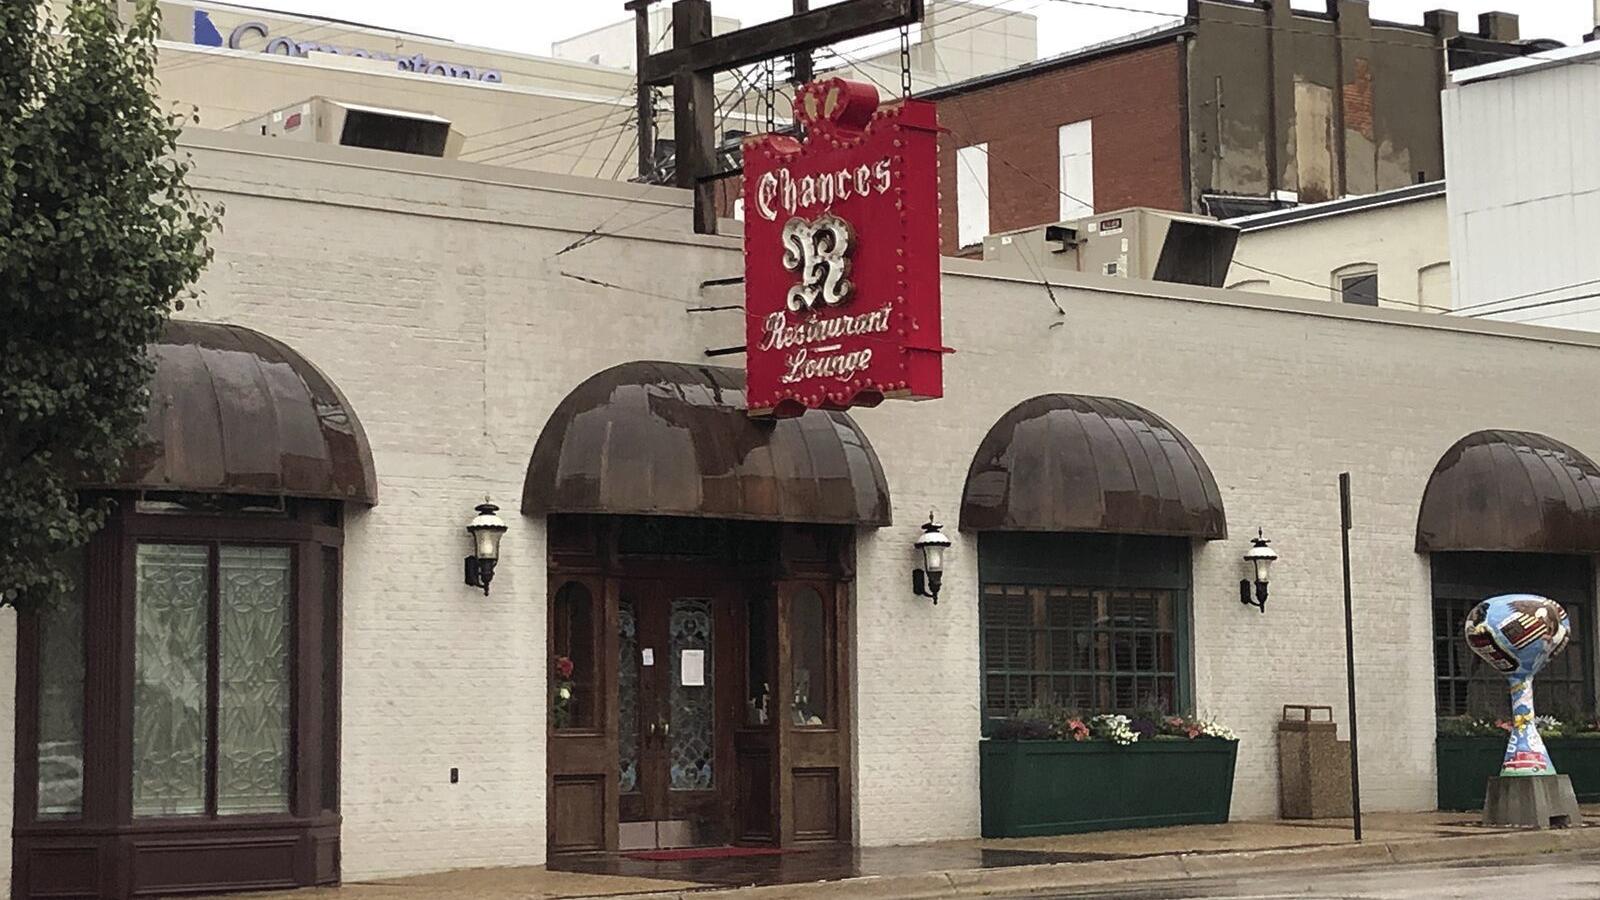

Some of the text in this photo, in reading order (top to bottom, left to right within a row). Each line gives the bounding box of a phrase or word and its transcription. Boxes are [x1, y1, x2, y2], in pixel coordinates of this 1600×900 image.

[755, 159, 892, 221] Chances
[782, 216, 854, 311] R
[758, 302, 893, 351] Restaurant
[779, 348, 872, 384] Lounge
